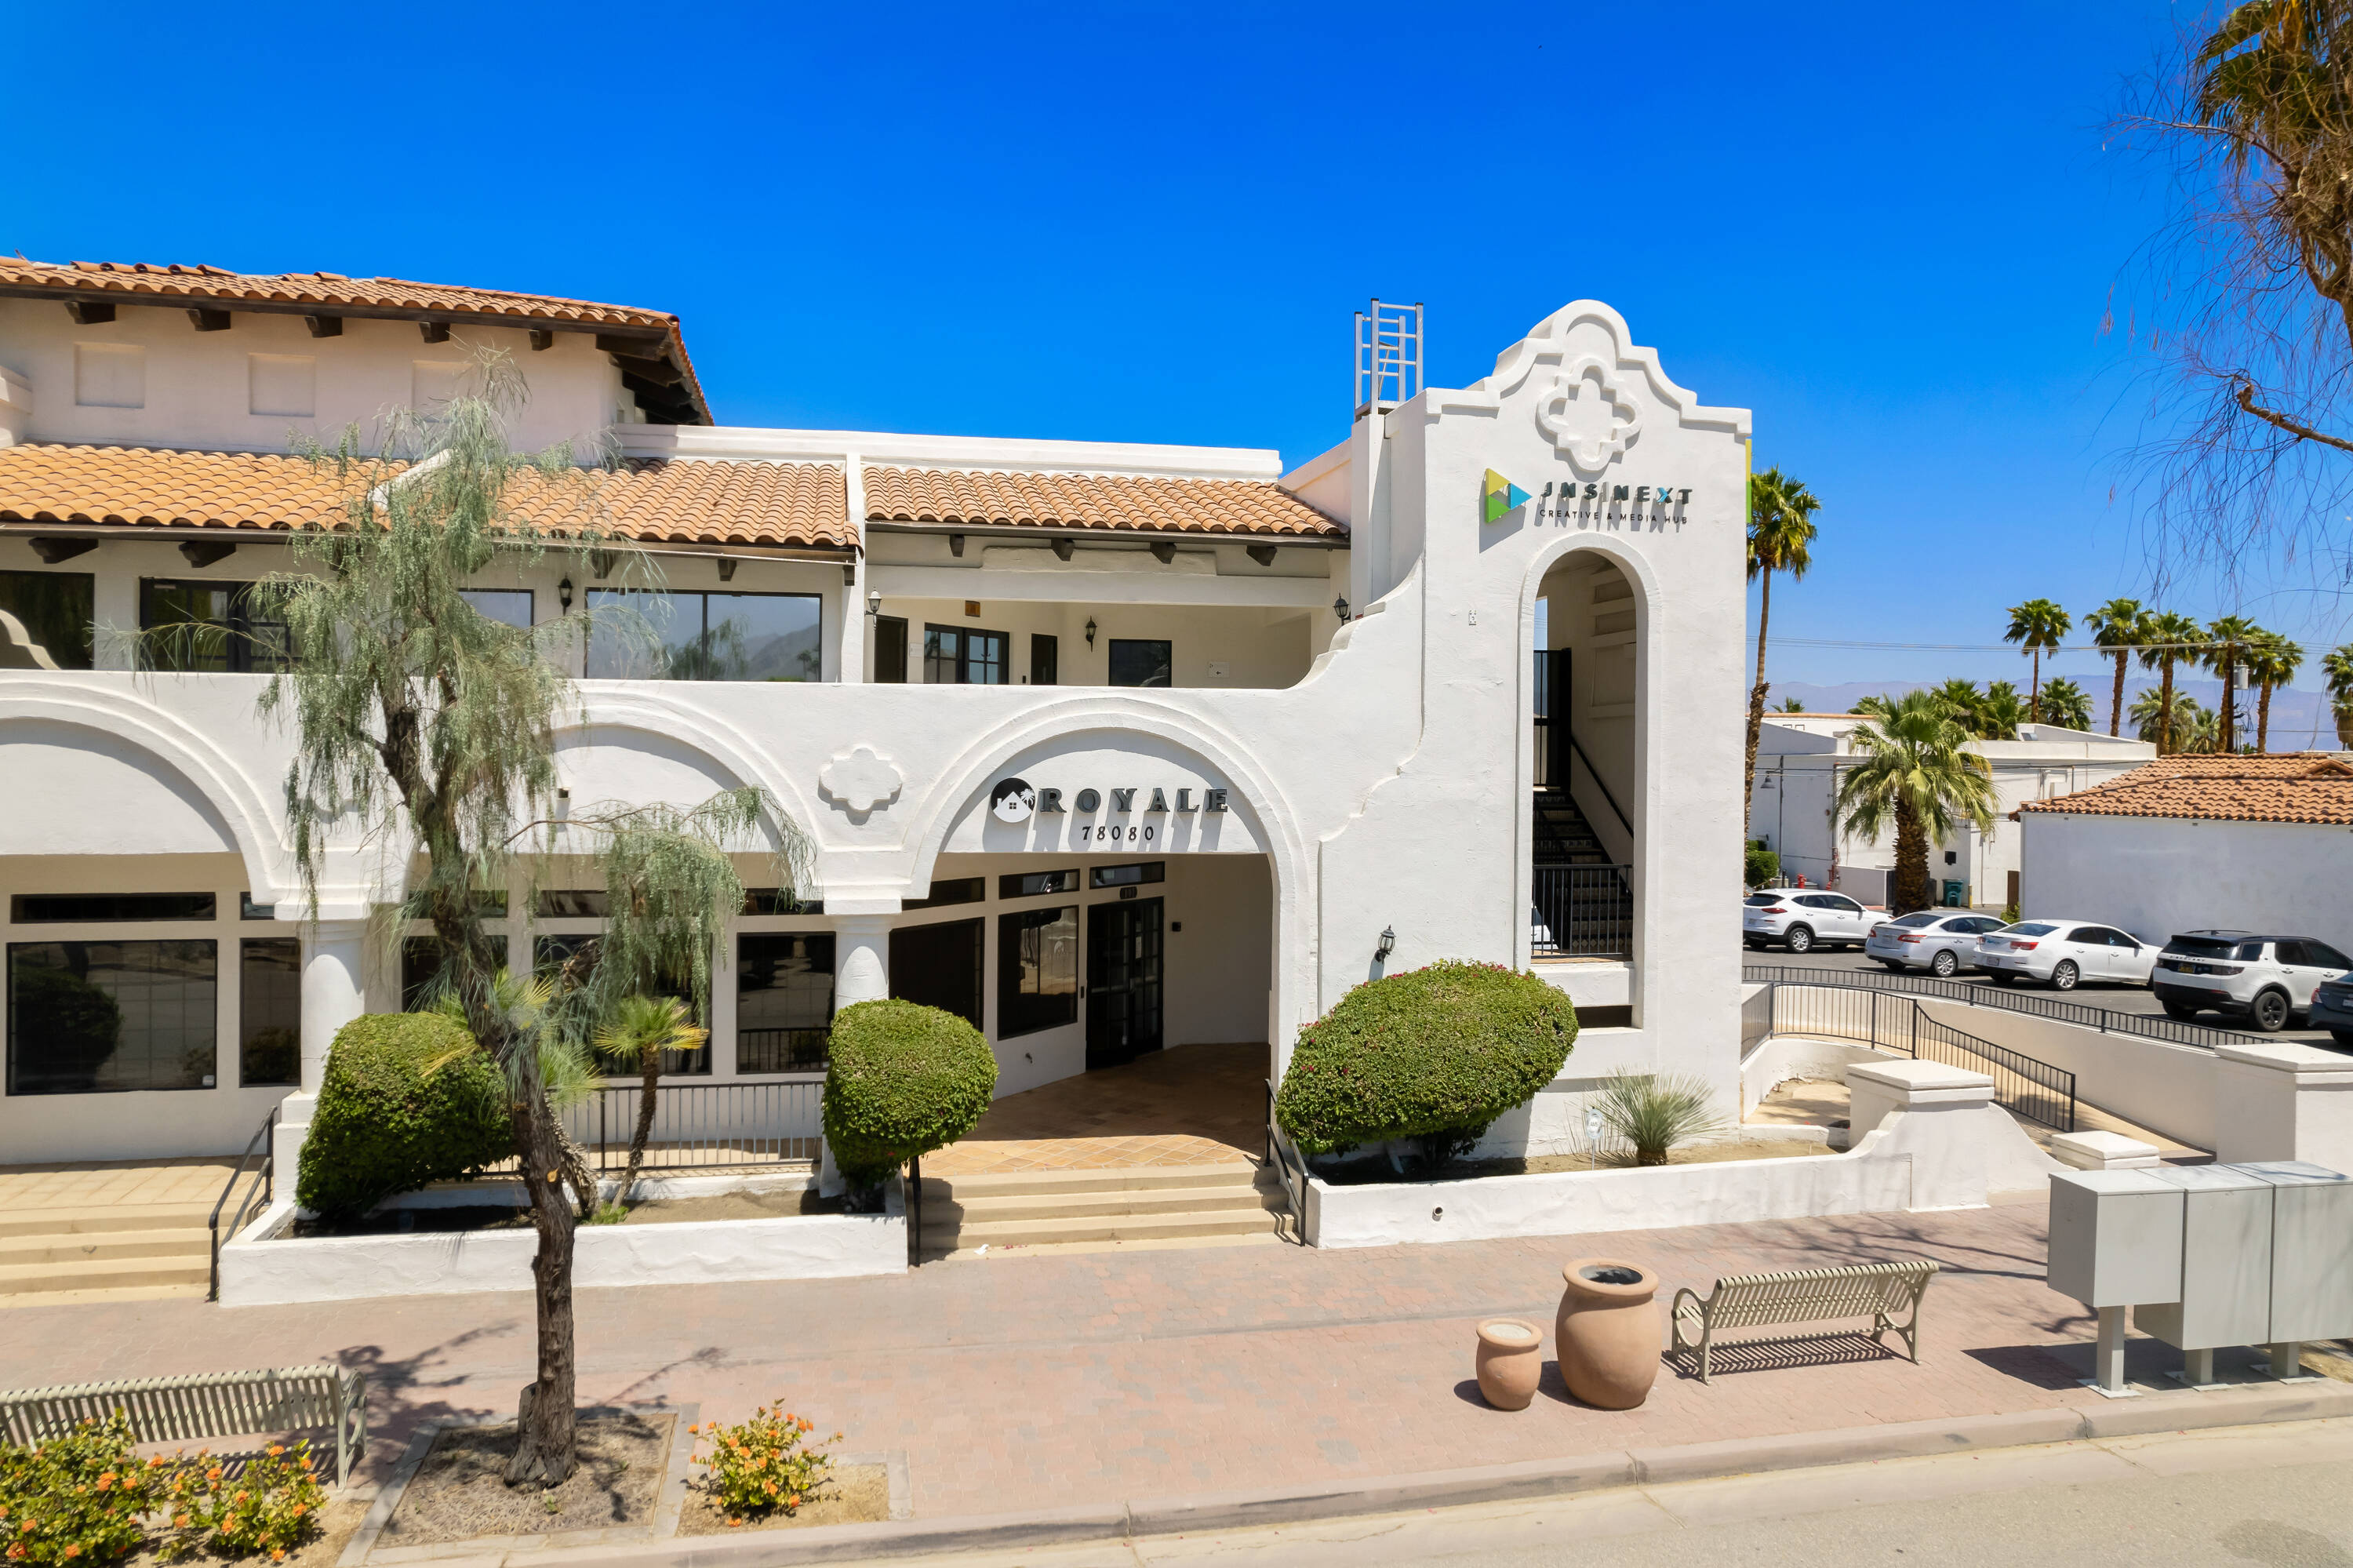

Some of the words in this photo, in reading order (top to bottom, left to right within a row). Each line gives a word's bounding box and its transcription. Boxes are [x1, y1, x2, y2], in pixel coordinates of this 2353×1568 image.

[1613, 485, 1693, 504] NEXT
[1540, 509, 1599, 519] CREATIVE
[1620, 514, 1657, 522] MEDIA
[1664, 515, 1687, 524] HUB
[1039, 788, 1228, 813] ROYALE
[1082, 826, 1155, 841] 78080
